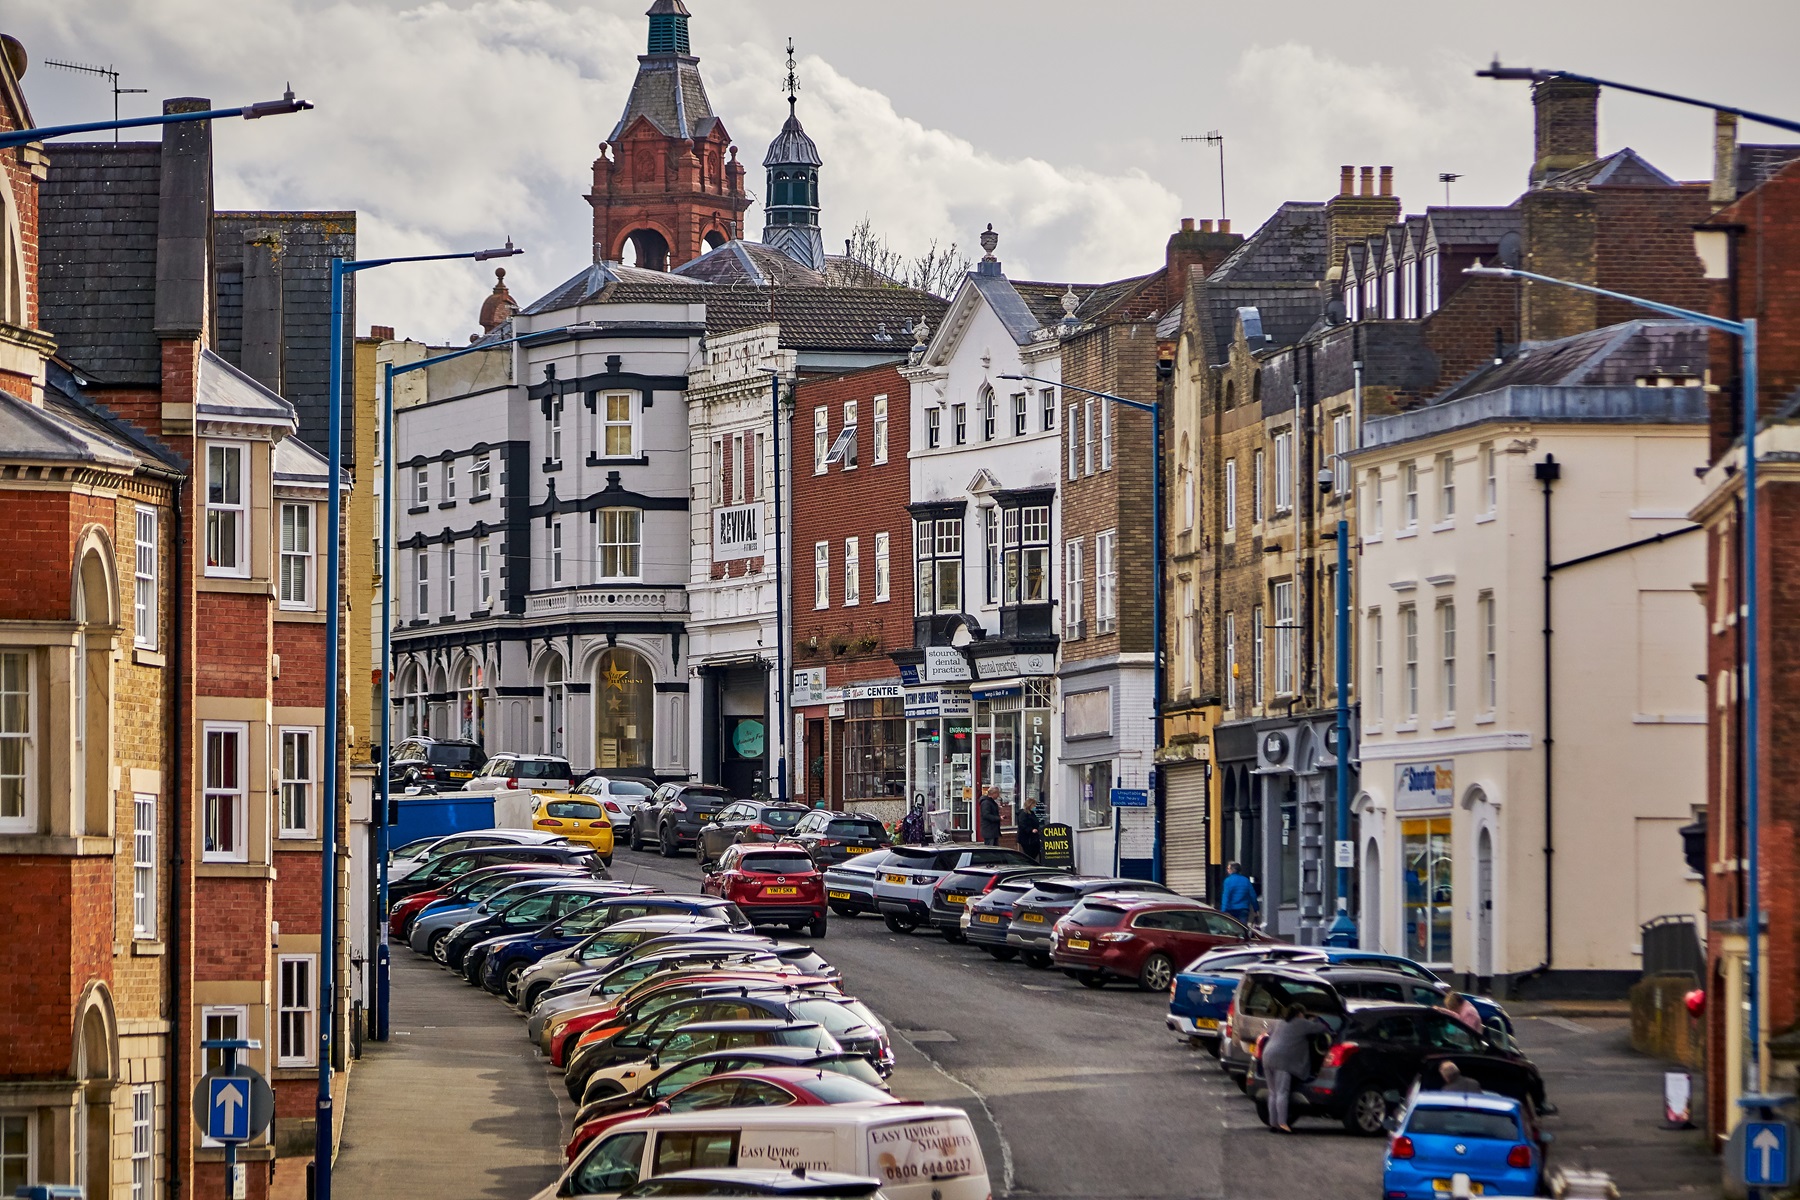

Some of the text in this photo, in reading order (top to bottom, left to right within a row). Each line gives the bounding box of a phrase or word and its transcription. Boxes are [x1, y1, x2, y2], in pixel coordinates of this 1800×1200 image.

[720, 508, 757, 544] REVIVAL
[743, 542, 758, 552] FITNESS
[935, 658, 960, 666] dental
[977, 659, 1018, 676] dental practice
[932, 666, 965, 676] practice
[867, 686, 899, 697] CENTRE
[1033, 716, 1043, 775] BLINDS
[1044, 827, 1067, 837] CHALK
[1045, 841, 1069, 850] PAINTS
[872, 1125, 940, 1144] EASY LIVING
[741, 1144, 800, 1161] EASY LIVING
[918, 1135, 972, 1155] STAIRLIFTS
[779, 1158, 829, 1171] MOBILITY
[886, 1158, 971, 1179] 0800 644 0237
